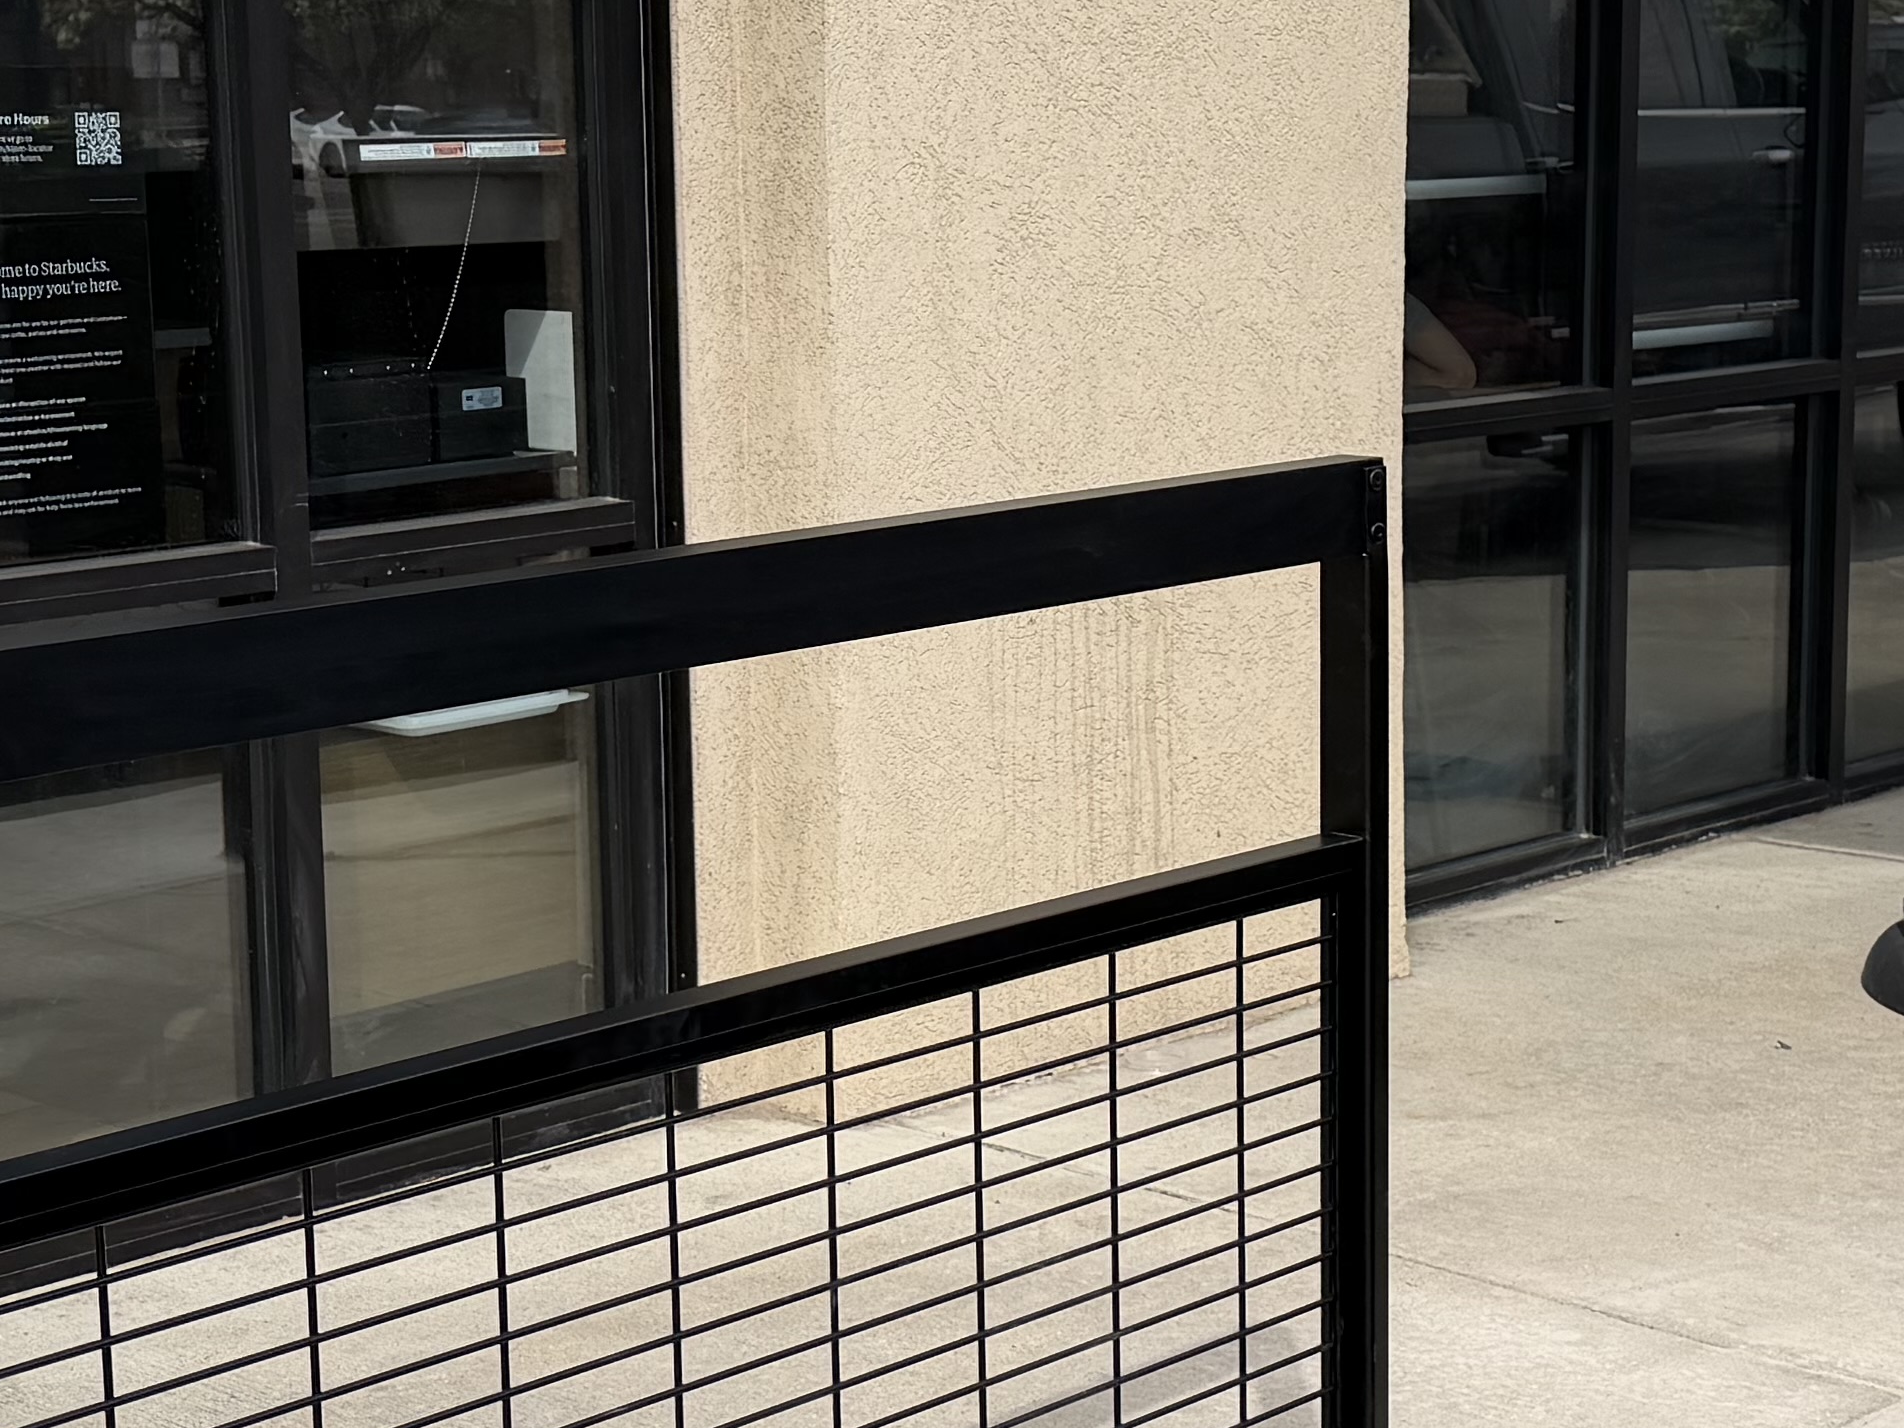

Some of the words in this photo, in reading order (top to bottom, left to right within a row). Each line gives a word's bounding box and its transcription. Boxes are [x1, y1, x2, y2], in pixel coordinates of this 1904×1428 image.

[13, 113, 50, 126] Hours
[25, 263, 39, 277] to
[41, 257, 110, 276] Starbucks.
[1, 283, 45, 301] happy
[46, 280, 88, 299] you're
[89, 278, 122, 293] here.
